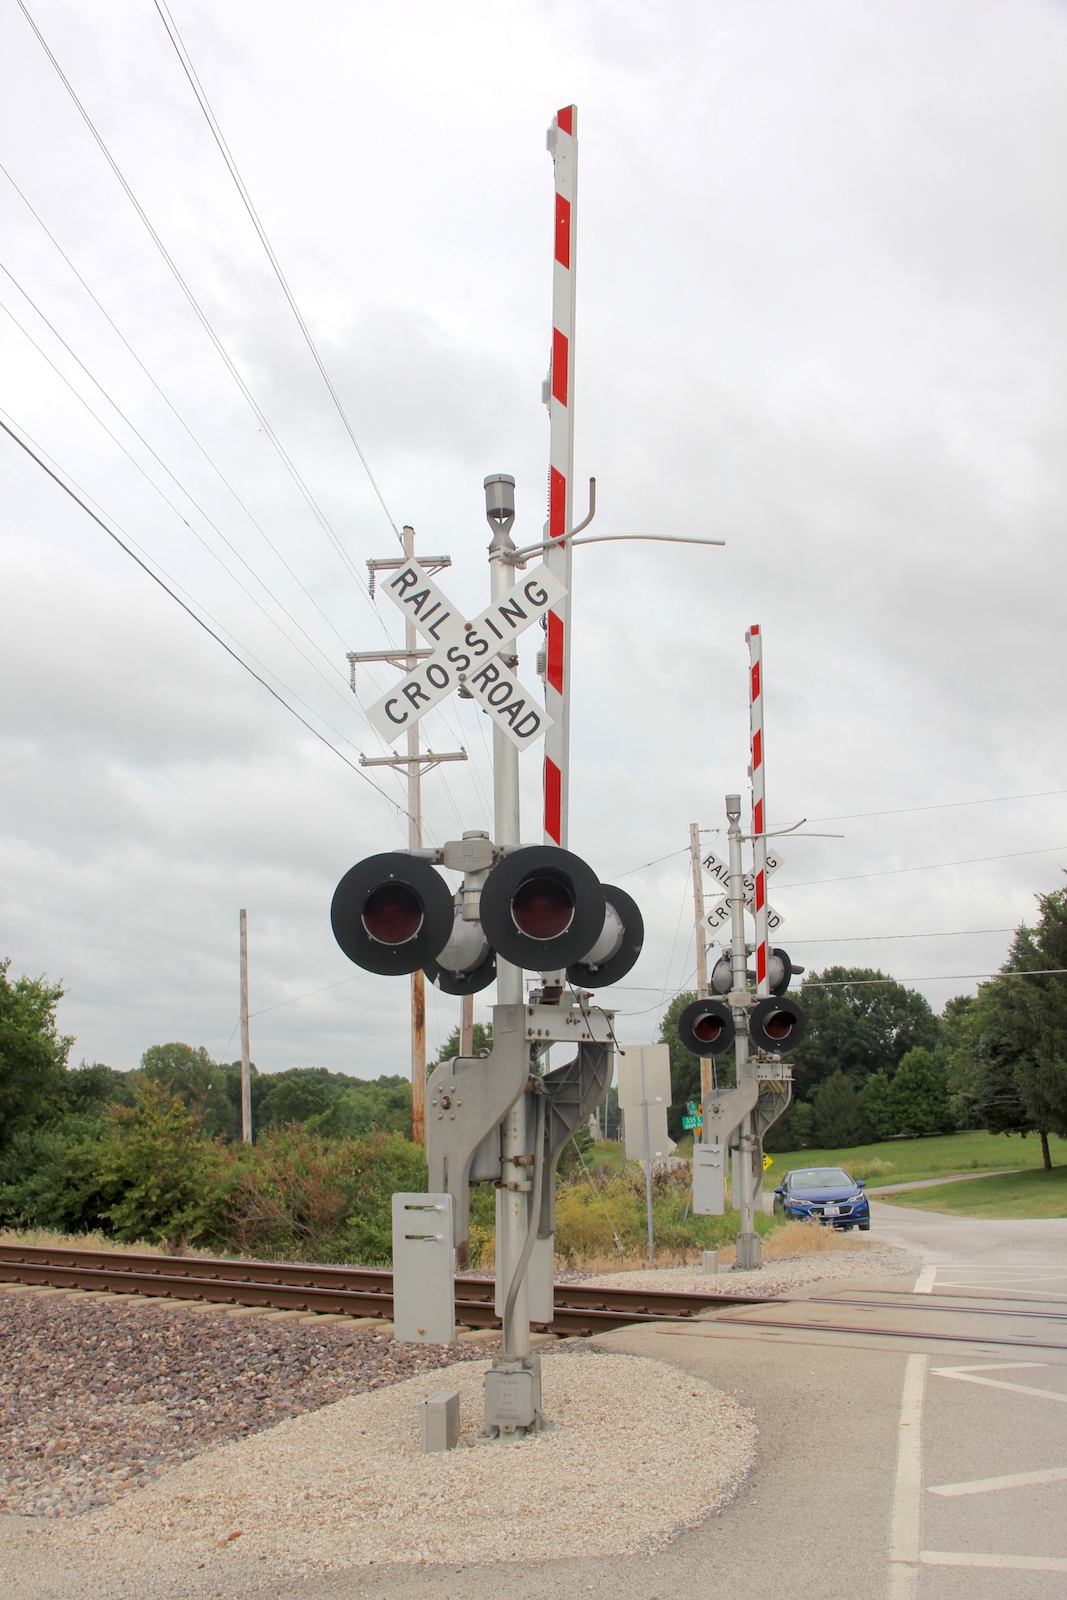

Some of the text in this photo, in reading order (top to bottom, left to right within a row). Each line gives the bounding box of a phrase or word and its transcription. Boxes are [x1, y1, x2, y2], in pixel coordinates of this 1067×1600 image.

[384, 581, 548, 725] CROSSING
[391, 567, 541, 738] RAIL ROAD
[703, 855, 731, 888] RAIL
